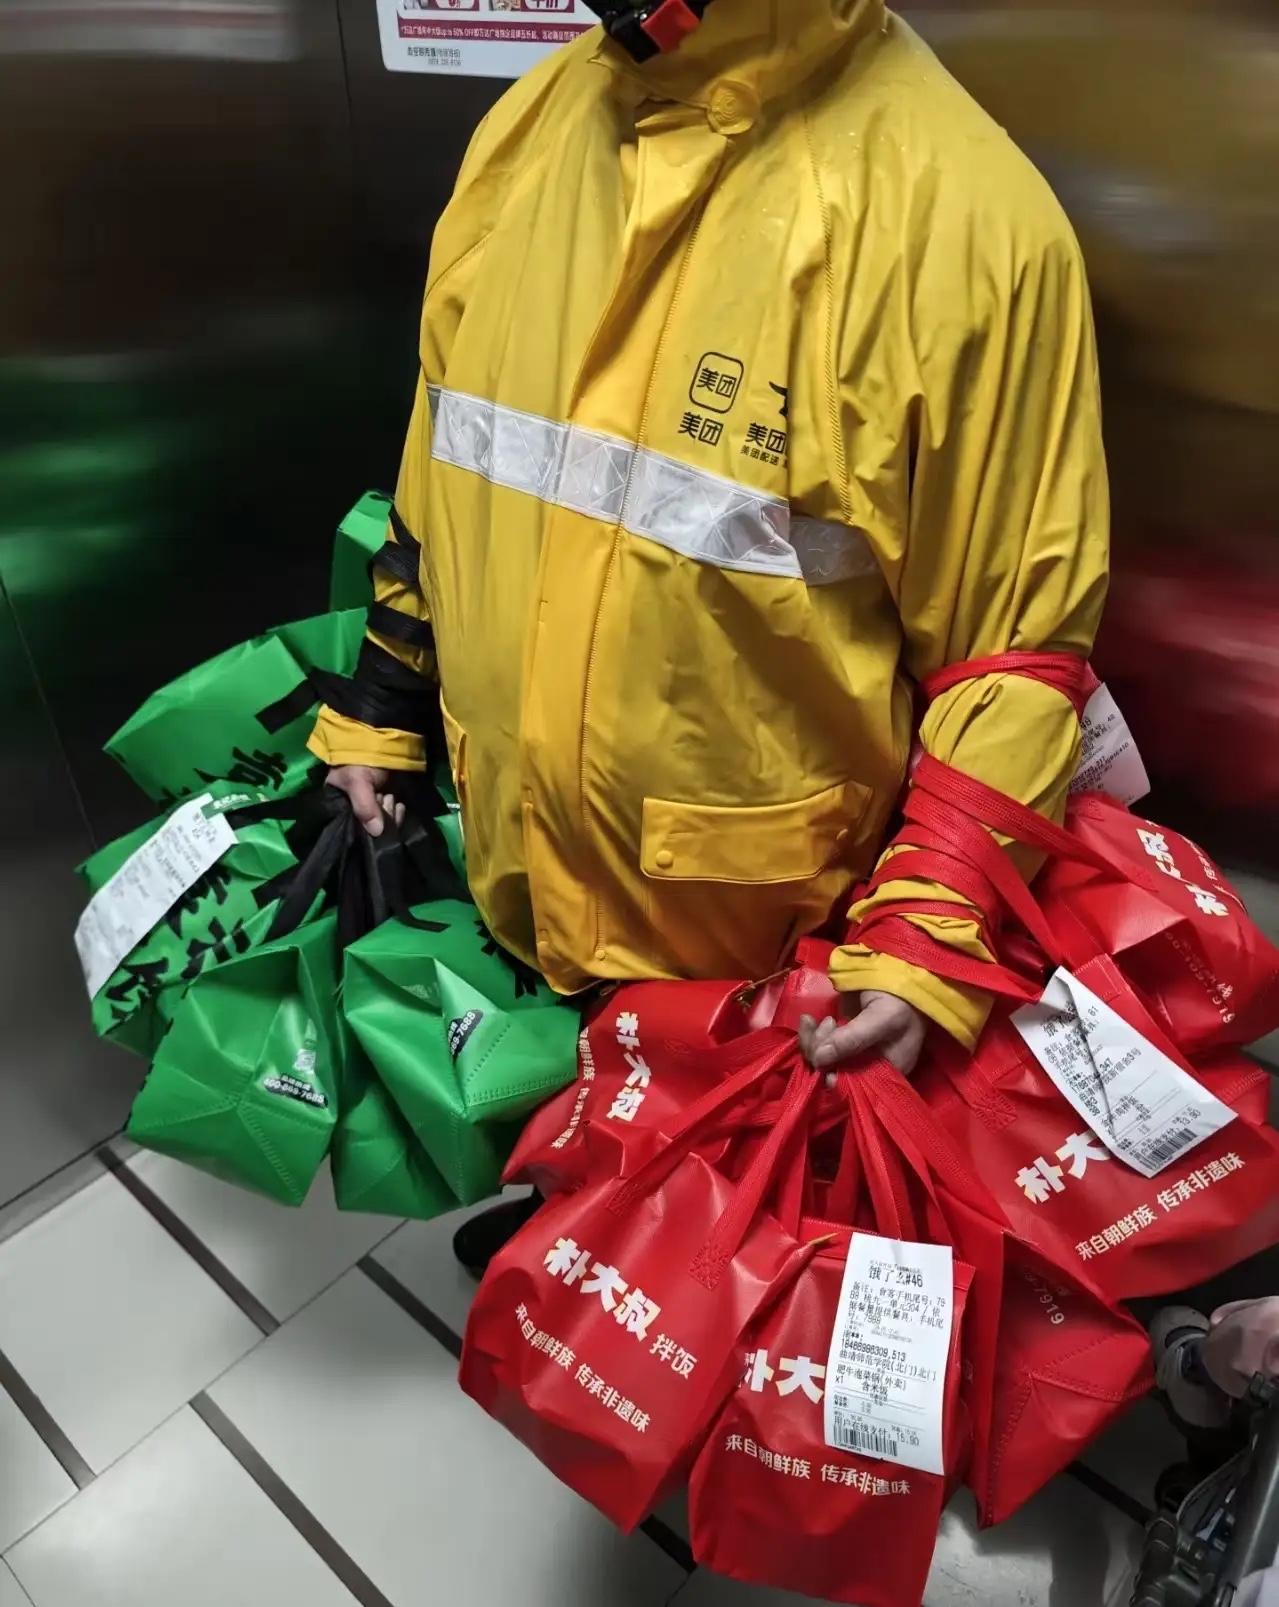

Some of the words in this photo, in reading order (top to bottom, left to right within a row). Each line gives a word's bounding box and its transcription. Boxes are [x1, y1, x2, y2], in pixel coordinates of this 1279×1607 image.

[696, 367, 737, 399] 美团
[678, 411, 724, 447] 美团
[745, 422, 787, 454] 美团
[740, 444, 780, 466] 美团配送
[1075, 1204, 1158, 1262] 来自朝鲜族
[1157, 1152, 1245, 1213] 传承非遗味
[543, 1237, 662, 1342] 朴大叔
[649, 1332, 698, 1380] 拌饭
[514, 1302, 577, 1372] 来自朝鲜族
[574, 1362, 651, 1433] 传承非遗味
[725, 1434, 811, 1480] 来自朝鲜族
[820, 1464, 911, 1496] 传承非遗味
